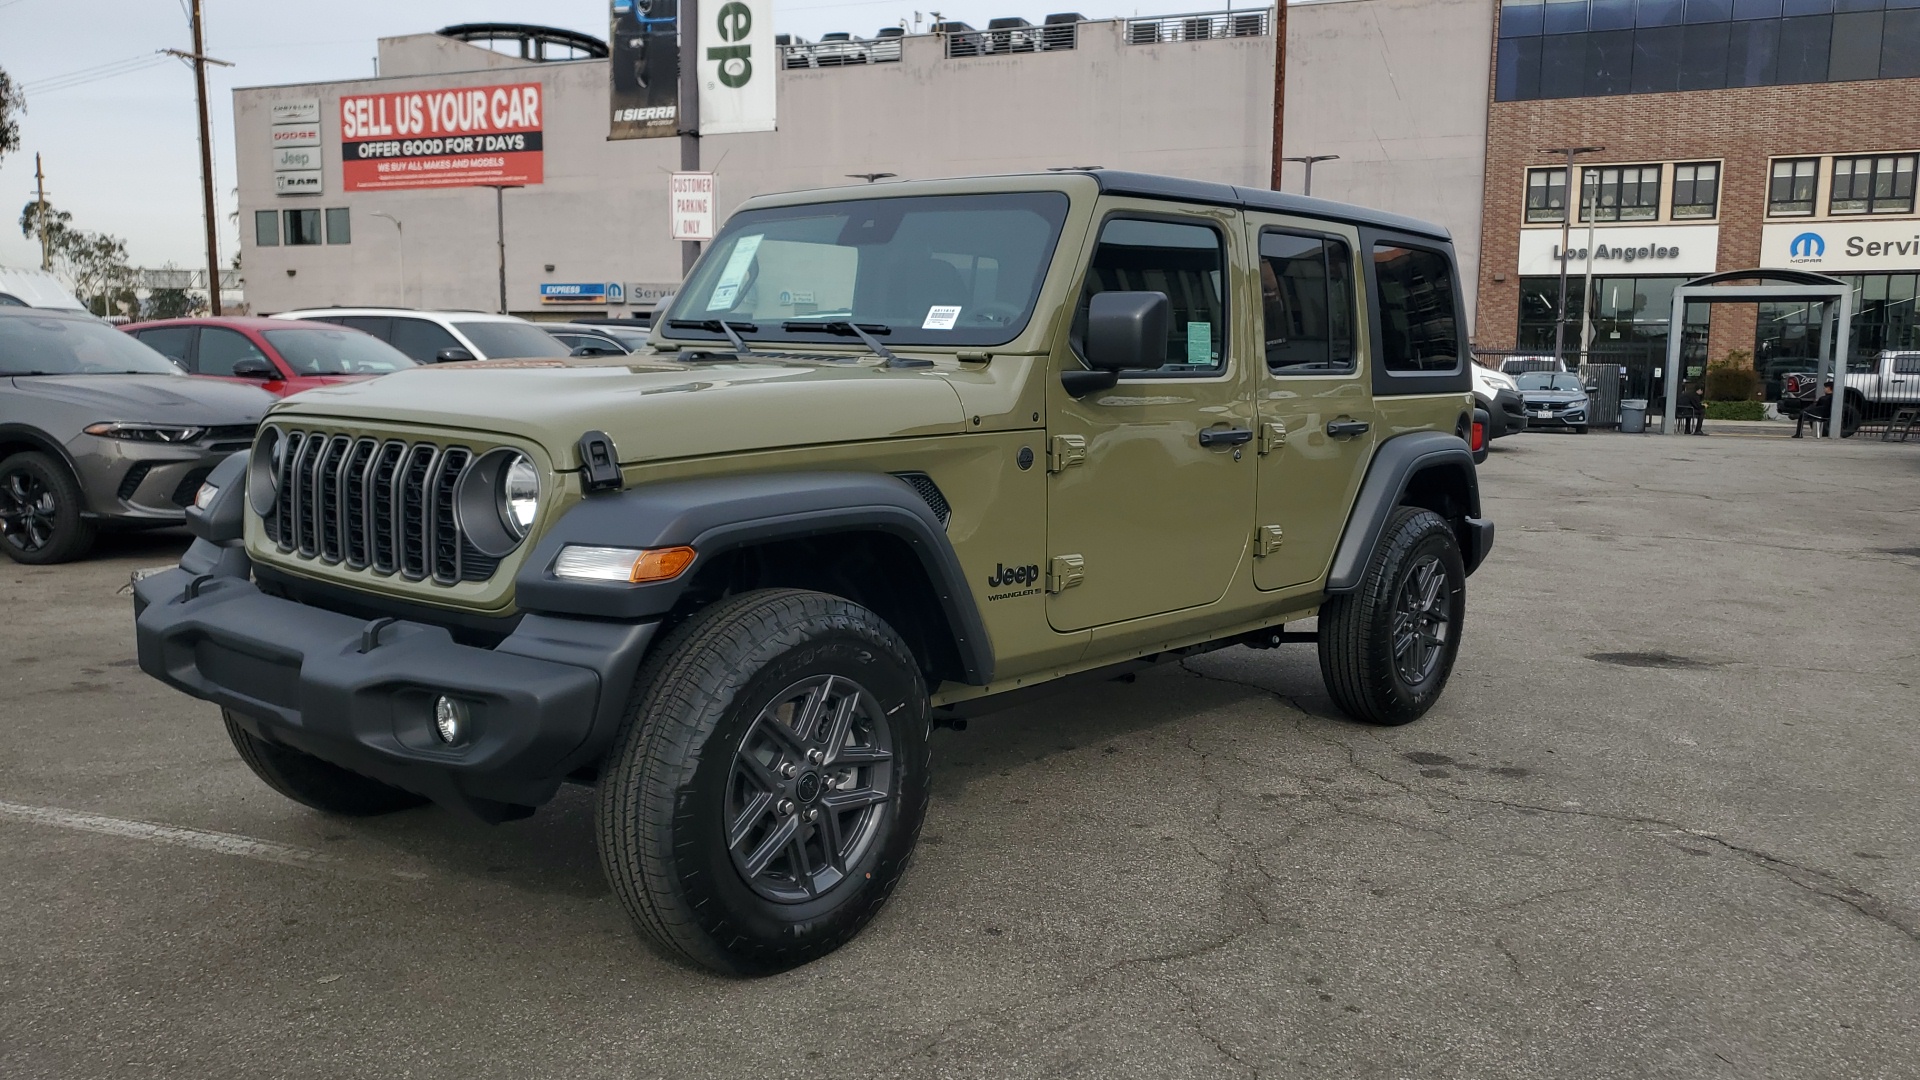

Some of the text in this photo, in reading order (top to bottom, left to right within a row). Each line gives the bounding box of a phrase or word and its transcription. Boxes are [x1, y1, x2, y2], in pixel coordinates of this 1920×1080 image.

[273, 103, 314, 112] CHRYSLER
[343, 86, 540, 138] SELL US YOUR CAR
[622, 106, 676, 122] SIERRA
[274, 132, 316, 141] DODGE
[358, 134, 525, 158] OFFER GOOD FOR 7 DAYS
[281, 150, 310, 168] Jeep
[377, 157, 505, 172] WE BUY ALL MAKES AND MODELS
[287, 178, 318, 186] RAM
[673, 178, 712, 194] CUSTOMER
[677, 198, 708, 214] PARKING
[683, 219, 701, 235] ONLY
[1553, 243, 1680, 262] Los Angeles
[1845, 235, 1920, 258] Servi
[546, 285, 581, 294] EXPRESS
[988, 562, 1039, 588] Jeep
[988, 590, 1034, 602] WRANGLER
